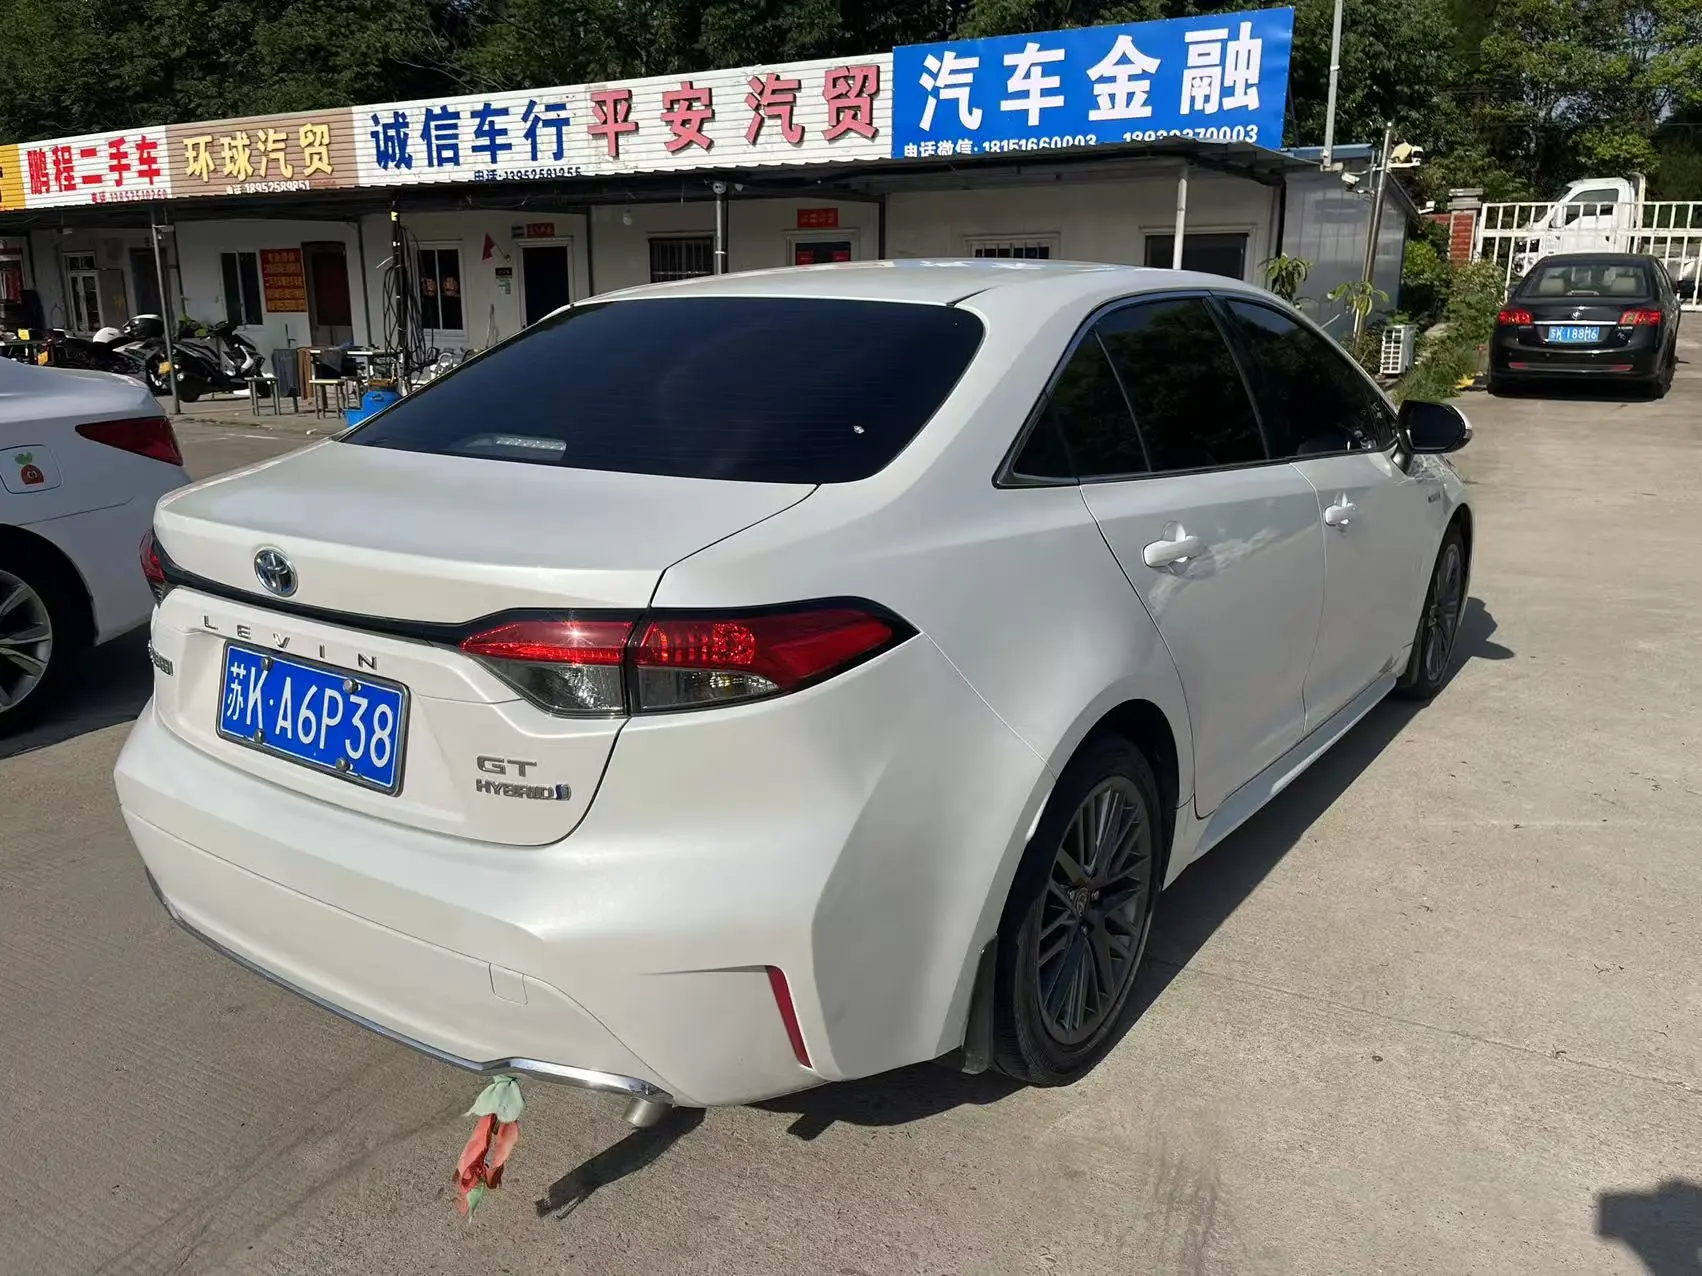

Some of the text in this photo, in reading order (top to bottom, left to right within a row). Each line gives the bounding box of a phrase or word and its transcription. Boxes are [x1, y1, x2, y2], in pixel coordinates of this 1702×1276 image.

[918, 21, 1263, 131] 汽车金融
[370, 99, 571, 171] 诚信车行
[587, 65, 880, 158] 平安汽贸
[27, 135, 161, 195] 鹏程二手车
[182, 123, 334, 182] 环球汽贸
[203, 615, 379, 671] LEVIN
[475, 778, 555, 800] HYBRID
[476, 754, 538, 778] GT
